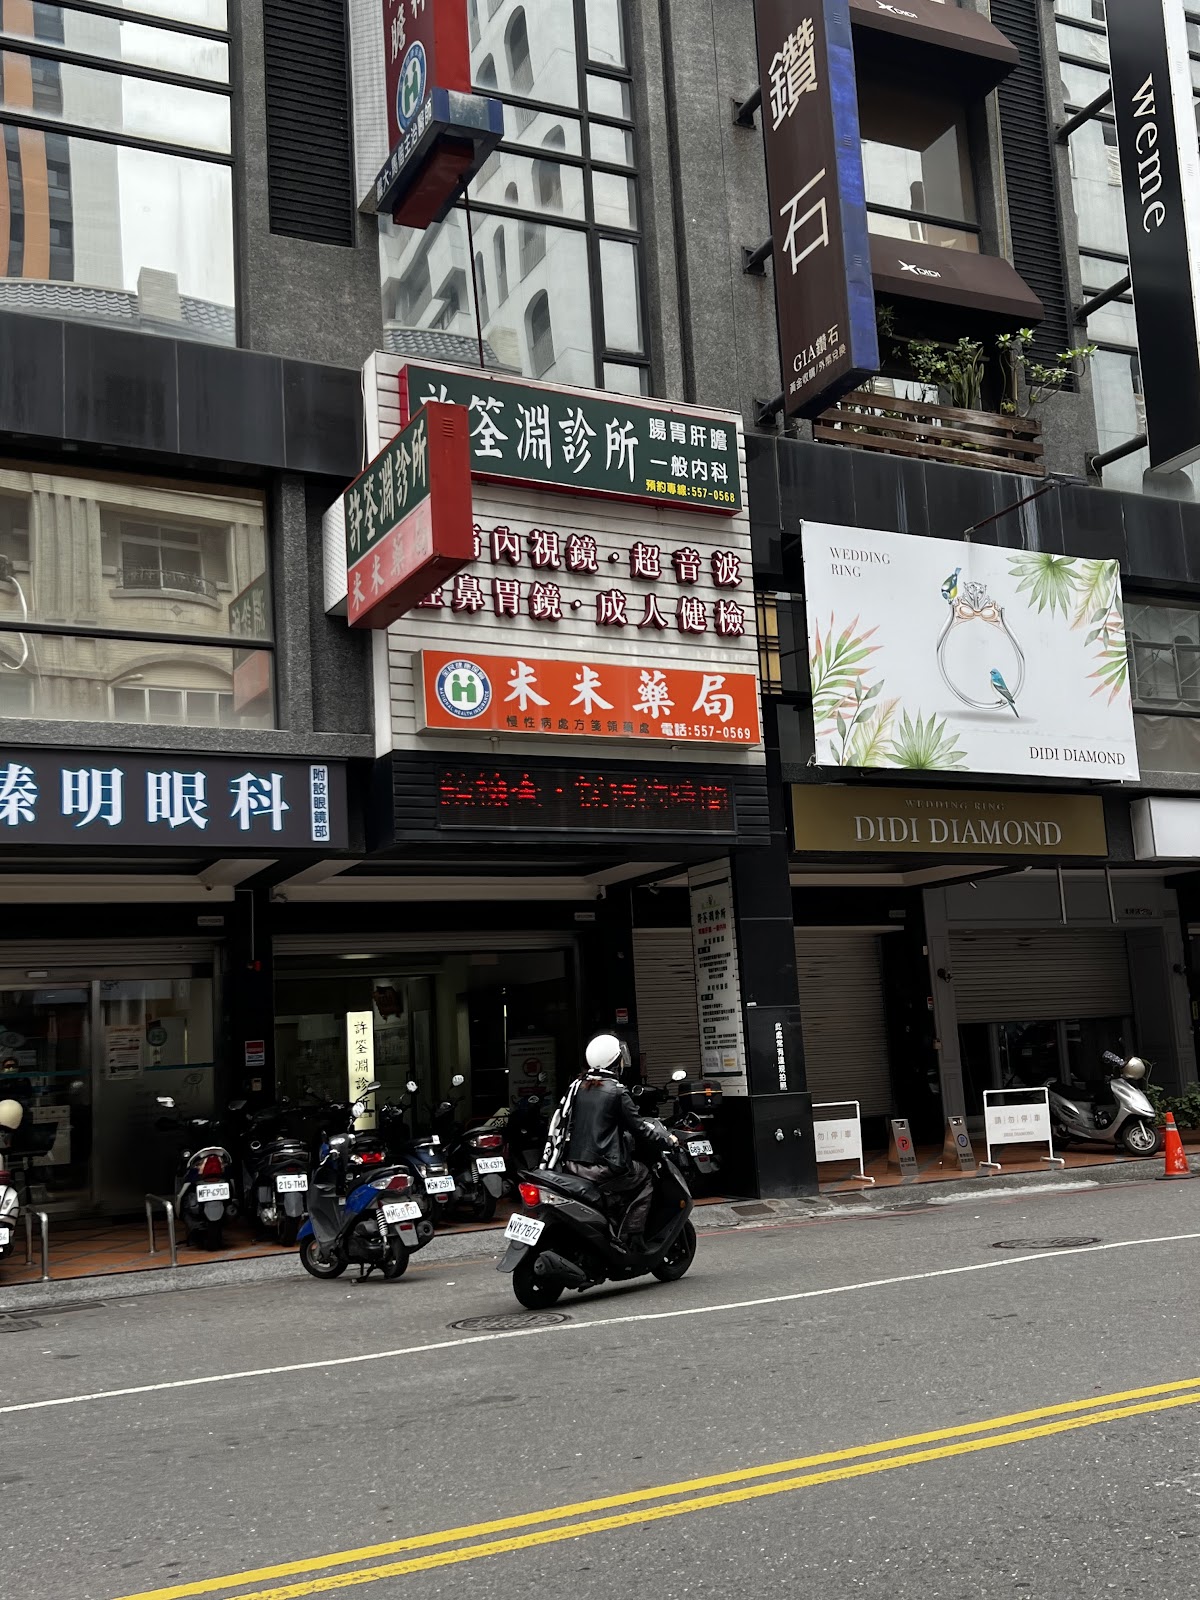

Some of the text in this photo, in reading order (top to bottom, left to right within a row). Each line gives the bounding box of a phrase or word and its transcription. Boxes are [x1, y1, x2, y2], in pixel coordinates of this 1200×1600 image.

[768, 18, 830, 275] 鑽石
[1132, 73, 1166, 232] weme
[420, 383, 638, 482] 筌淵診所
[348, 419, 427, 552] 許筌淵診所
[829, 546, 891, 565] WEDDING
[831, 563, 861, 578] RING
[504, 660, 734, 722] 米米藥局
[660, 722, 751, 739] 電話:557-0569
[1029, 747, 1126, 766] DIDI DIAMOND
[313, 768, 328, 838] 附設眼鏡部
[904, 799, 1006, 811] WEDDING RING
[853, 816, 1063, 847] DIDI DIAMOND
